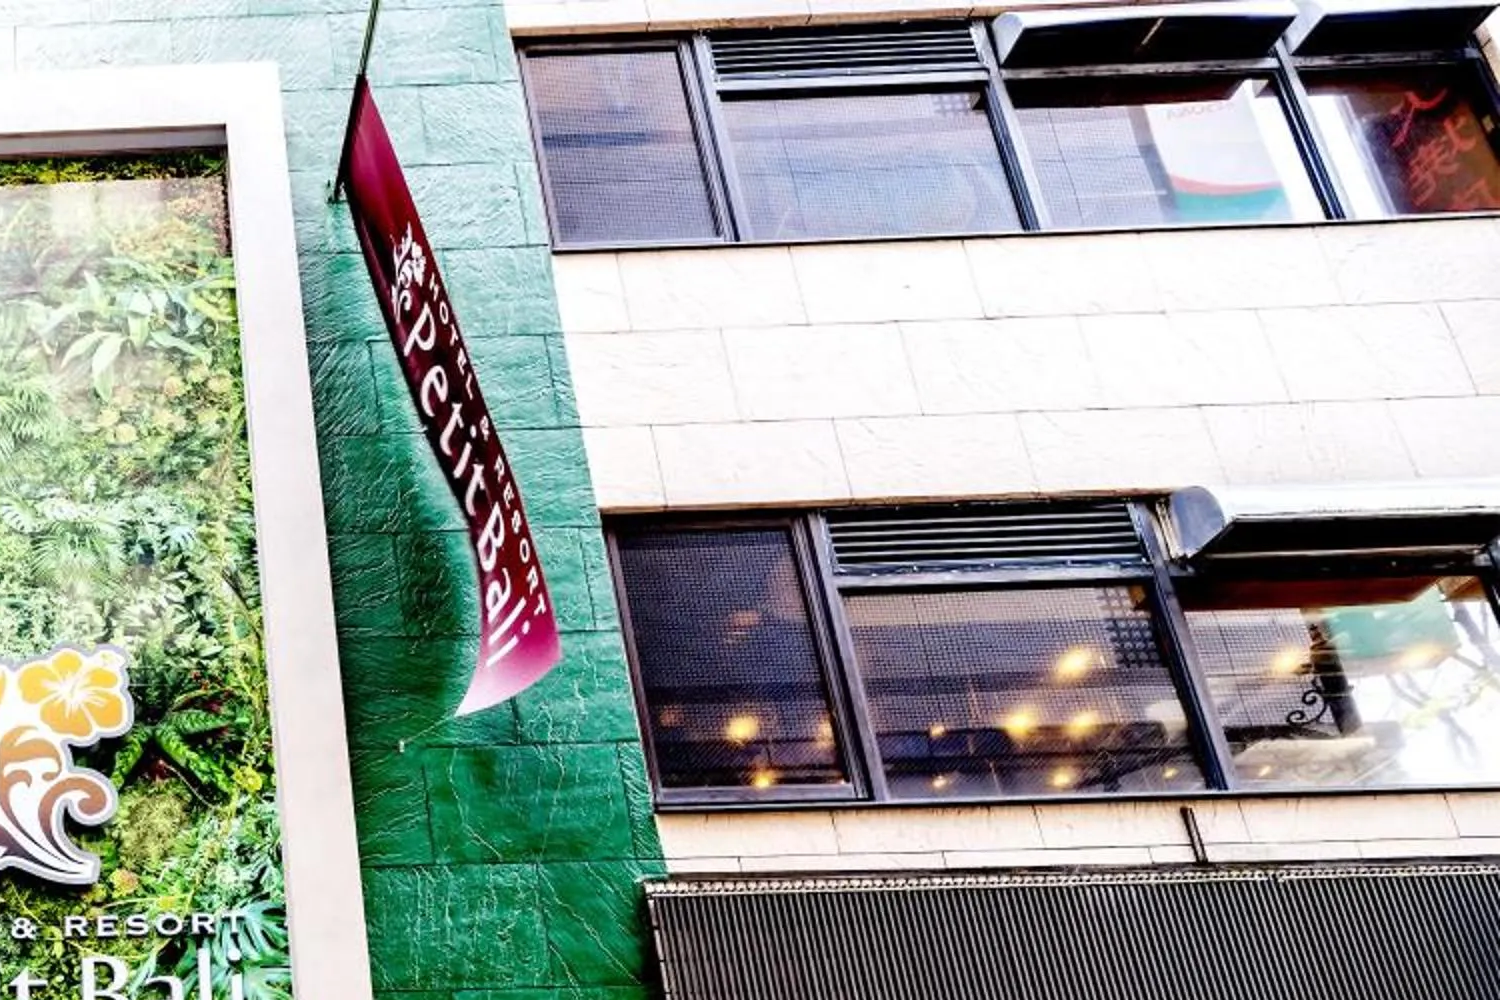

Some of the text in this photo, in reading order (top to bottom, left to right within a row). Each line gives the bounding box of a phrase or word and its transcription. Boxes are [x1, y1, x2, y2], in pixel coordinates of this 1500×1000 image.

[403, 301, 531, 668] Petit Bali
[494, 453, 547, 617] RESORT
[10, 916, 38, 940] &
[63, 911, 248, 938] RESORT
